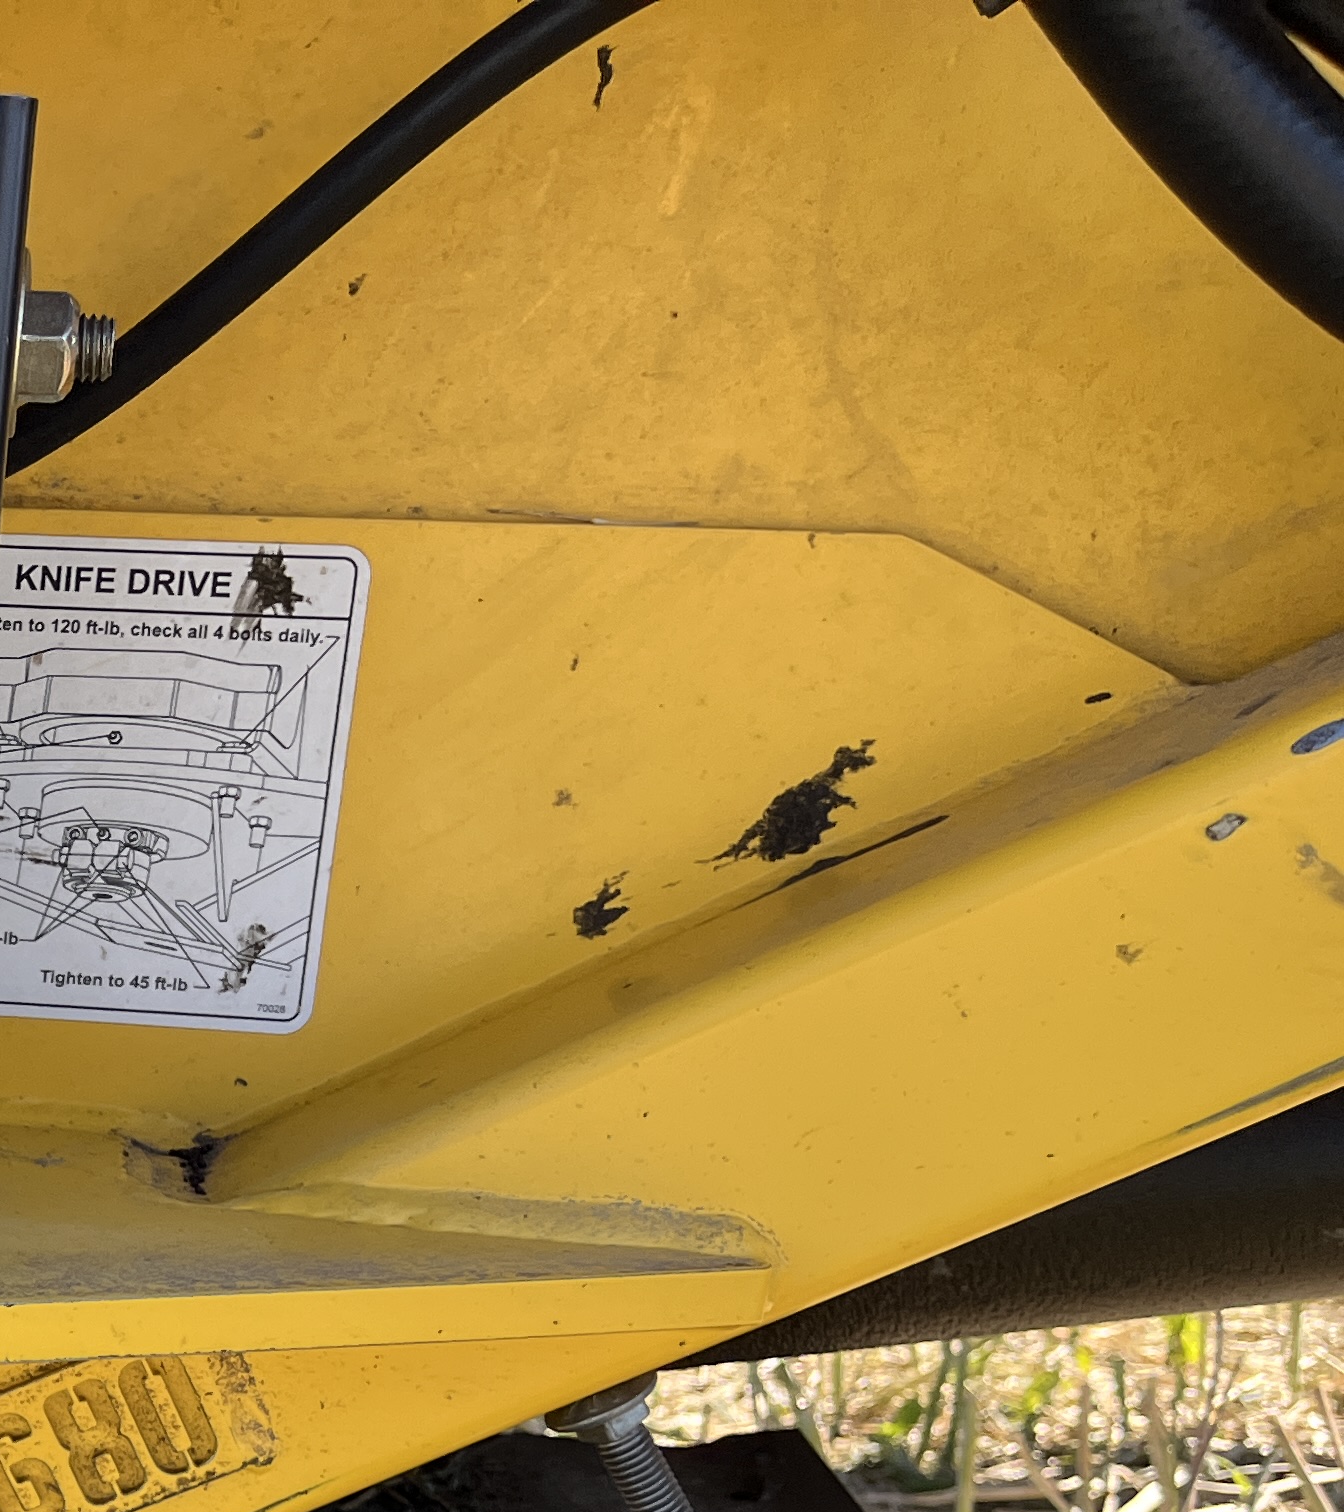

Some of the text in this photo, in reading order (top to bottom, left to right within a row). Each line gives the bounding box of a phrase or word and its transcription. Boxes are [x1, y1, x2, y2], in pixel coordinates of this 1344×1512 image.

[14, 564, 232, 598] KNIFE DRIVE
[28, 618, 45, 632] to
[51, 619, 81, 634] 120
[86, 620, 124, 638] ft-lb,
[130, 622, 182, 638] check
[187, 624, 208, 639] all
[213, 625, 224, 640] 4
[229, 625, 272, 641] bolts
[278, 627, 324, 647] daily.
[40, 969, 188, 991] Tighten to 45 ft-lb
